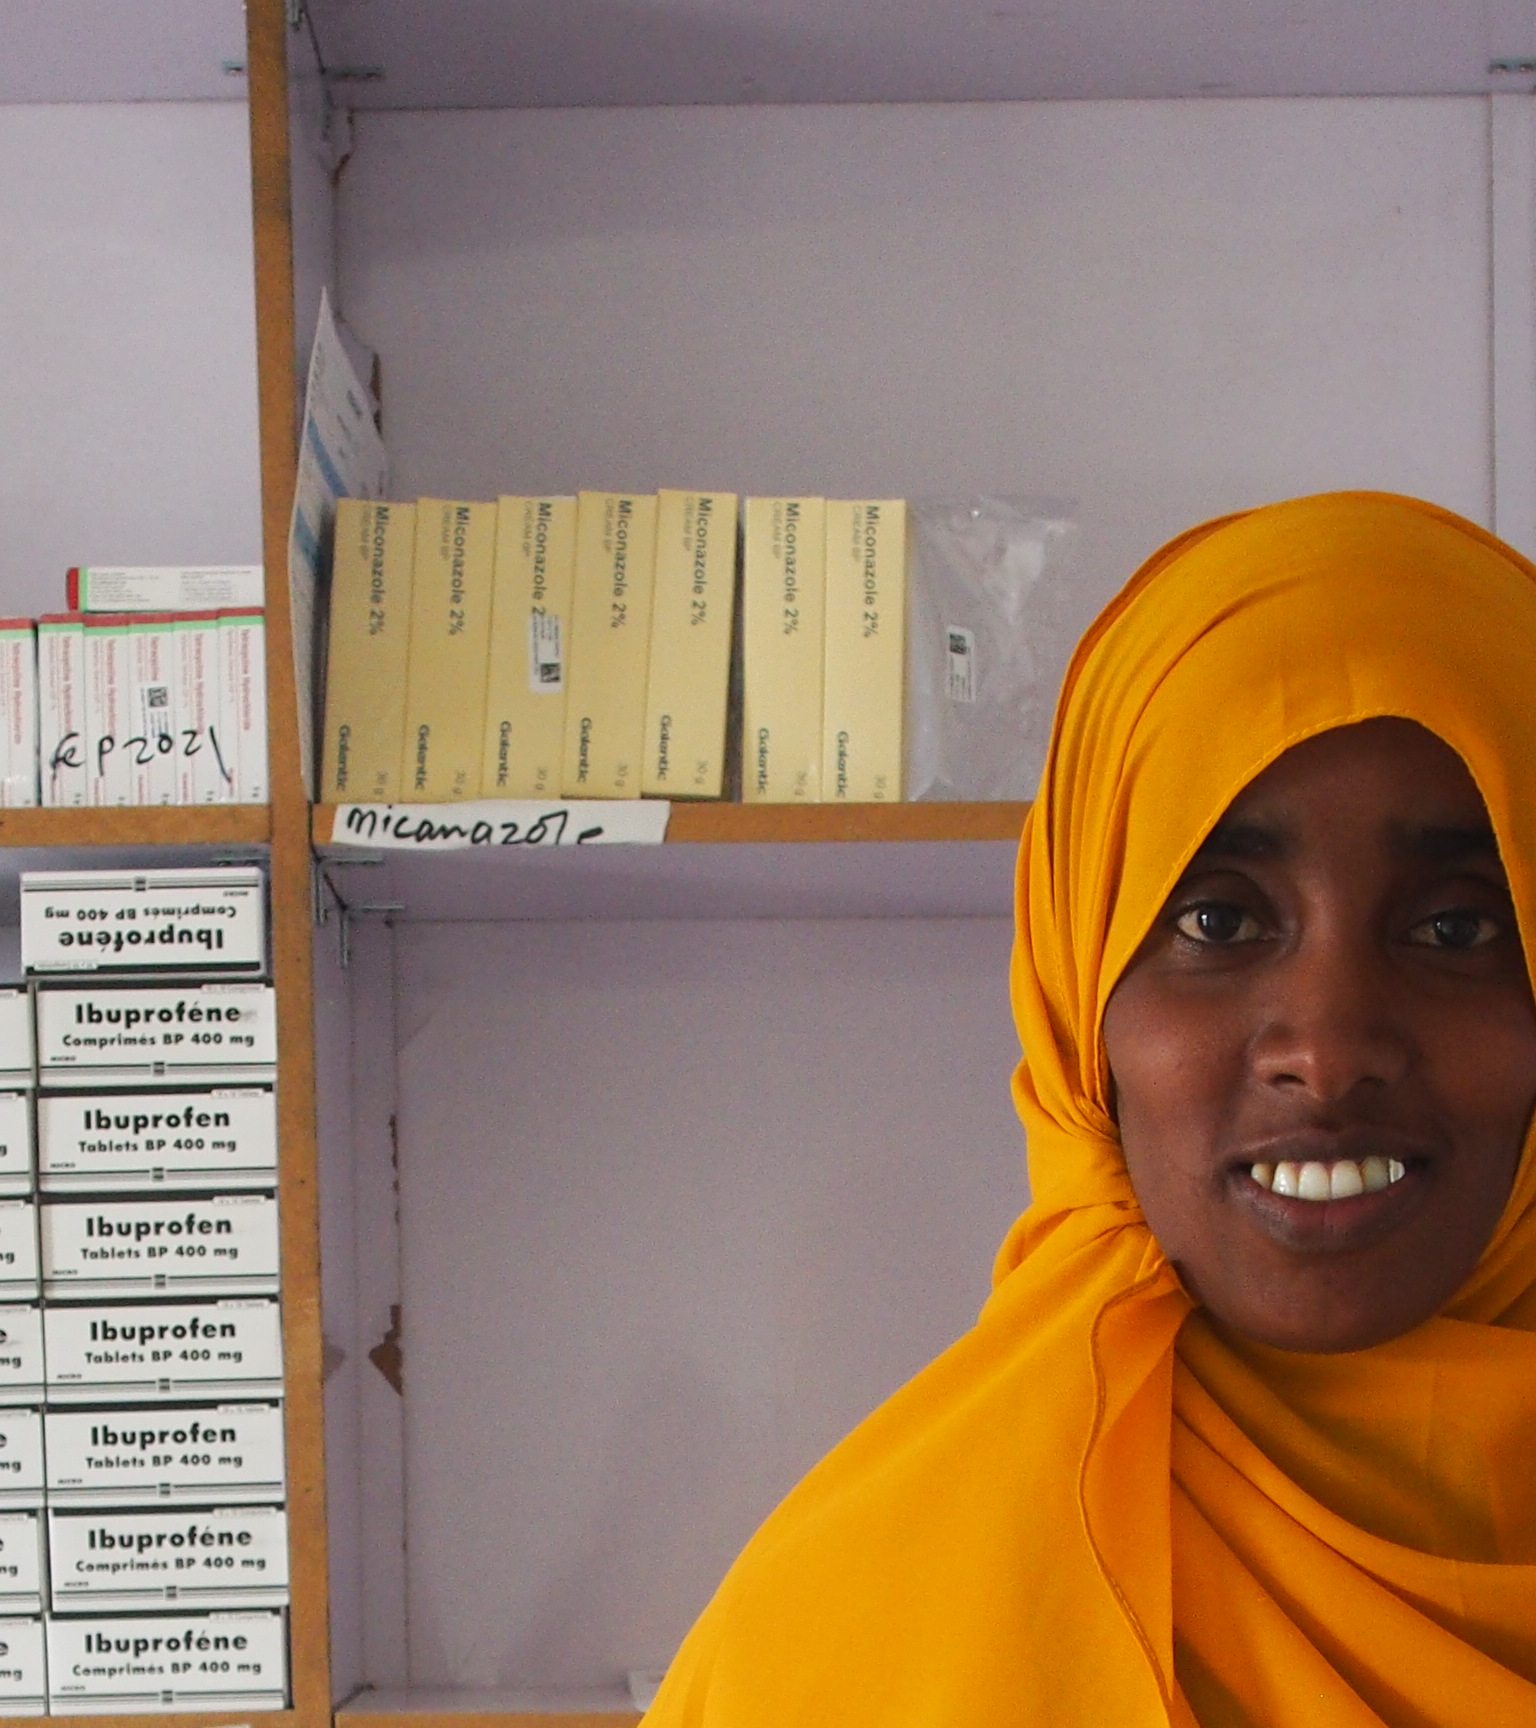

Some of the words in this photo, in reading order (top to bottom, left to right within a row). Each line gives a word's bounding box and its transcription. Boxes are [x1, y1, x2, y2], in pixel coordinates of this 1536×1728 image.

[369, 505, 391, 604] Miconazole
[451, 506, 471, 605] Miconazole
[613, 500, 633, 596] Miconazole
[693, 497, 713, 595] Miconazole
[785, 501, 799, 604] Miconazole
[865, 505, 879, 604] Miconazole
[368, 607, 384, 635] 2%
[689, 600, 706, 626] 2%
[862, 607, 879, 638] 2%
[45, 904, 68, 921] mg
[78, 904, 108, 921] 400
[115, 904, 137, 921] BP
[143, 904, 236, 921] Comprimés
[59, 924, 223, 954] Ibuproféne
[84, 1109, 230, 1136] Ibuprofen
[85, 1629, 248, 1658] Ibuproféne
